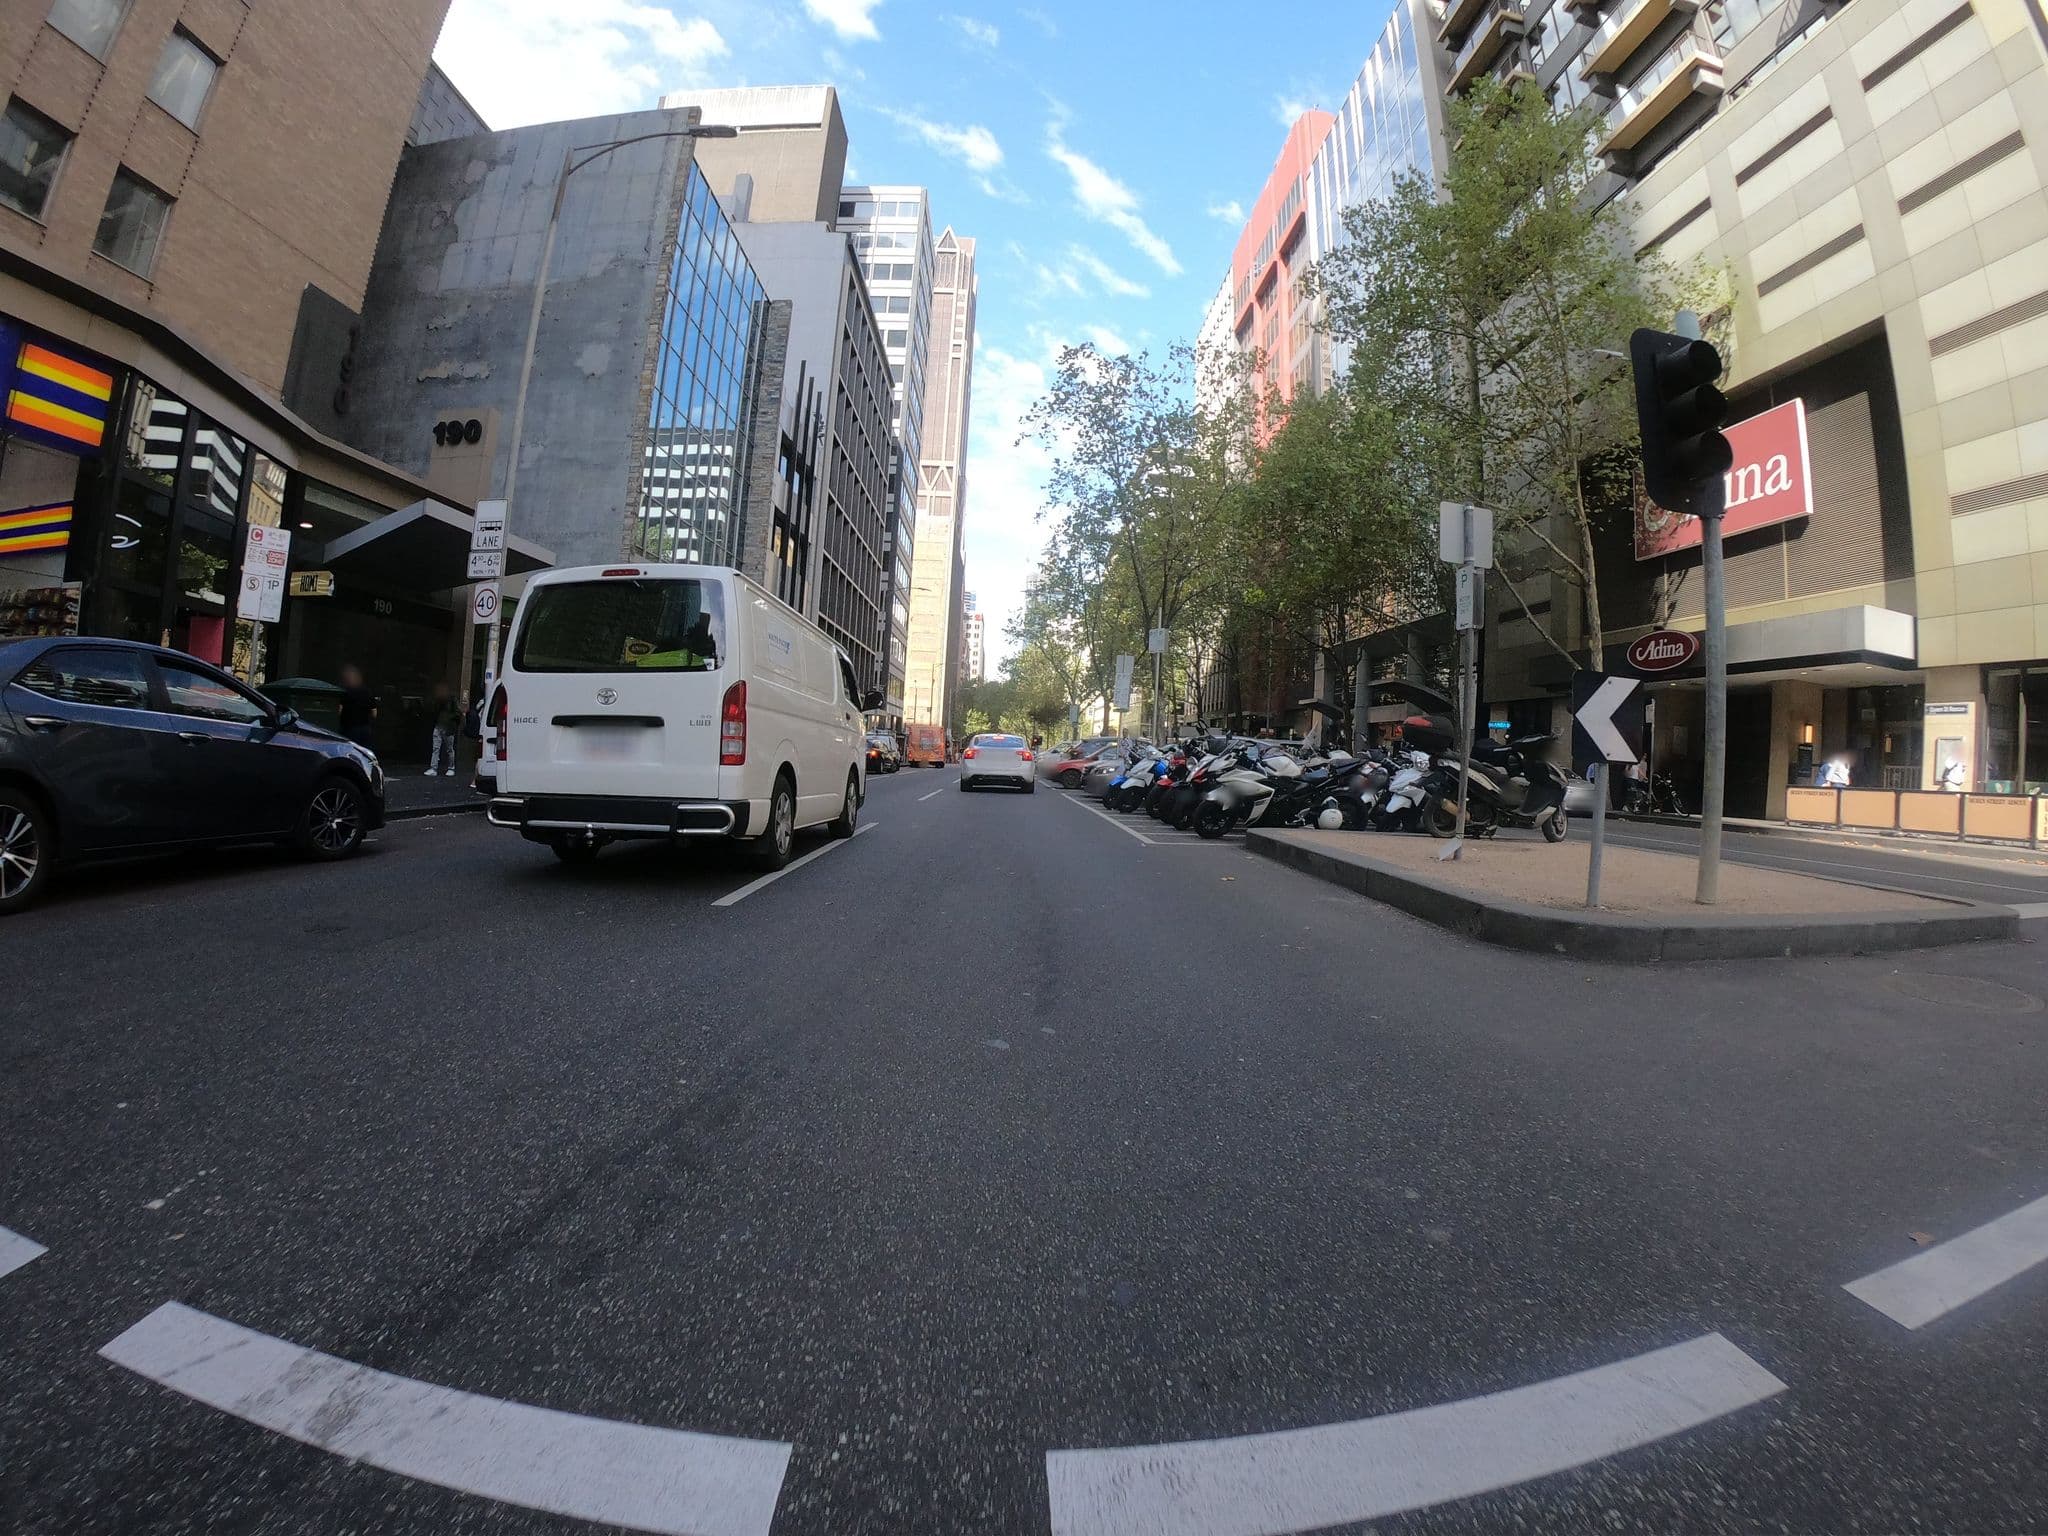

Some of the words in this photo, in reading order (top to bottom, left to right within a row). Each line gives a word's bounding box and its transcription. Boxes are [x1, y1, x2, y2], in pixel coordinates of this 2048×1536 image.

[433, 419, 482, 447] 190
[476, 536, 500, 548] LANE
[374, 599, 392, 614] 190
[477, 596, 495, 610] 40
[1635, 639, 1685, 660] Adina
